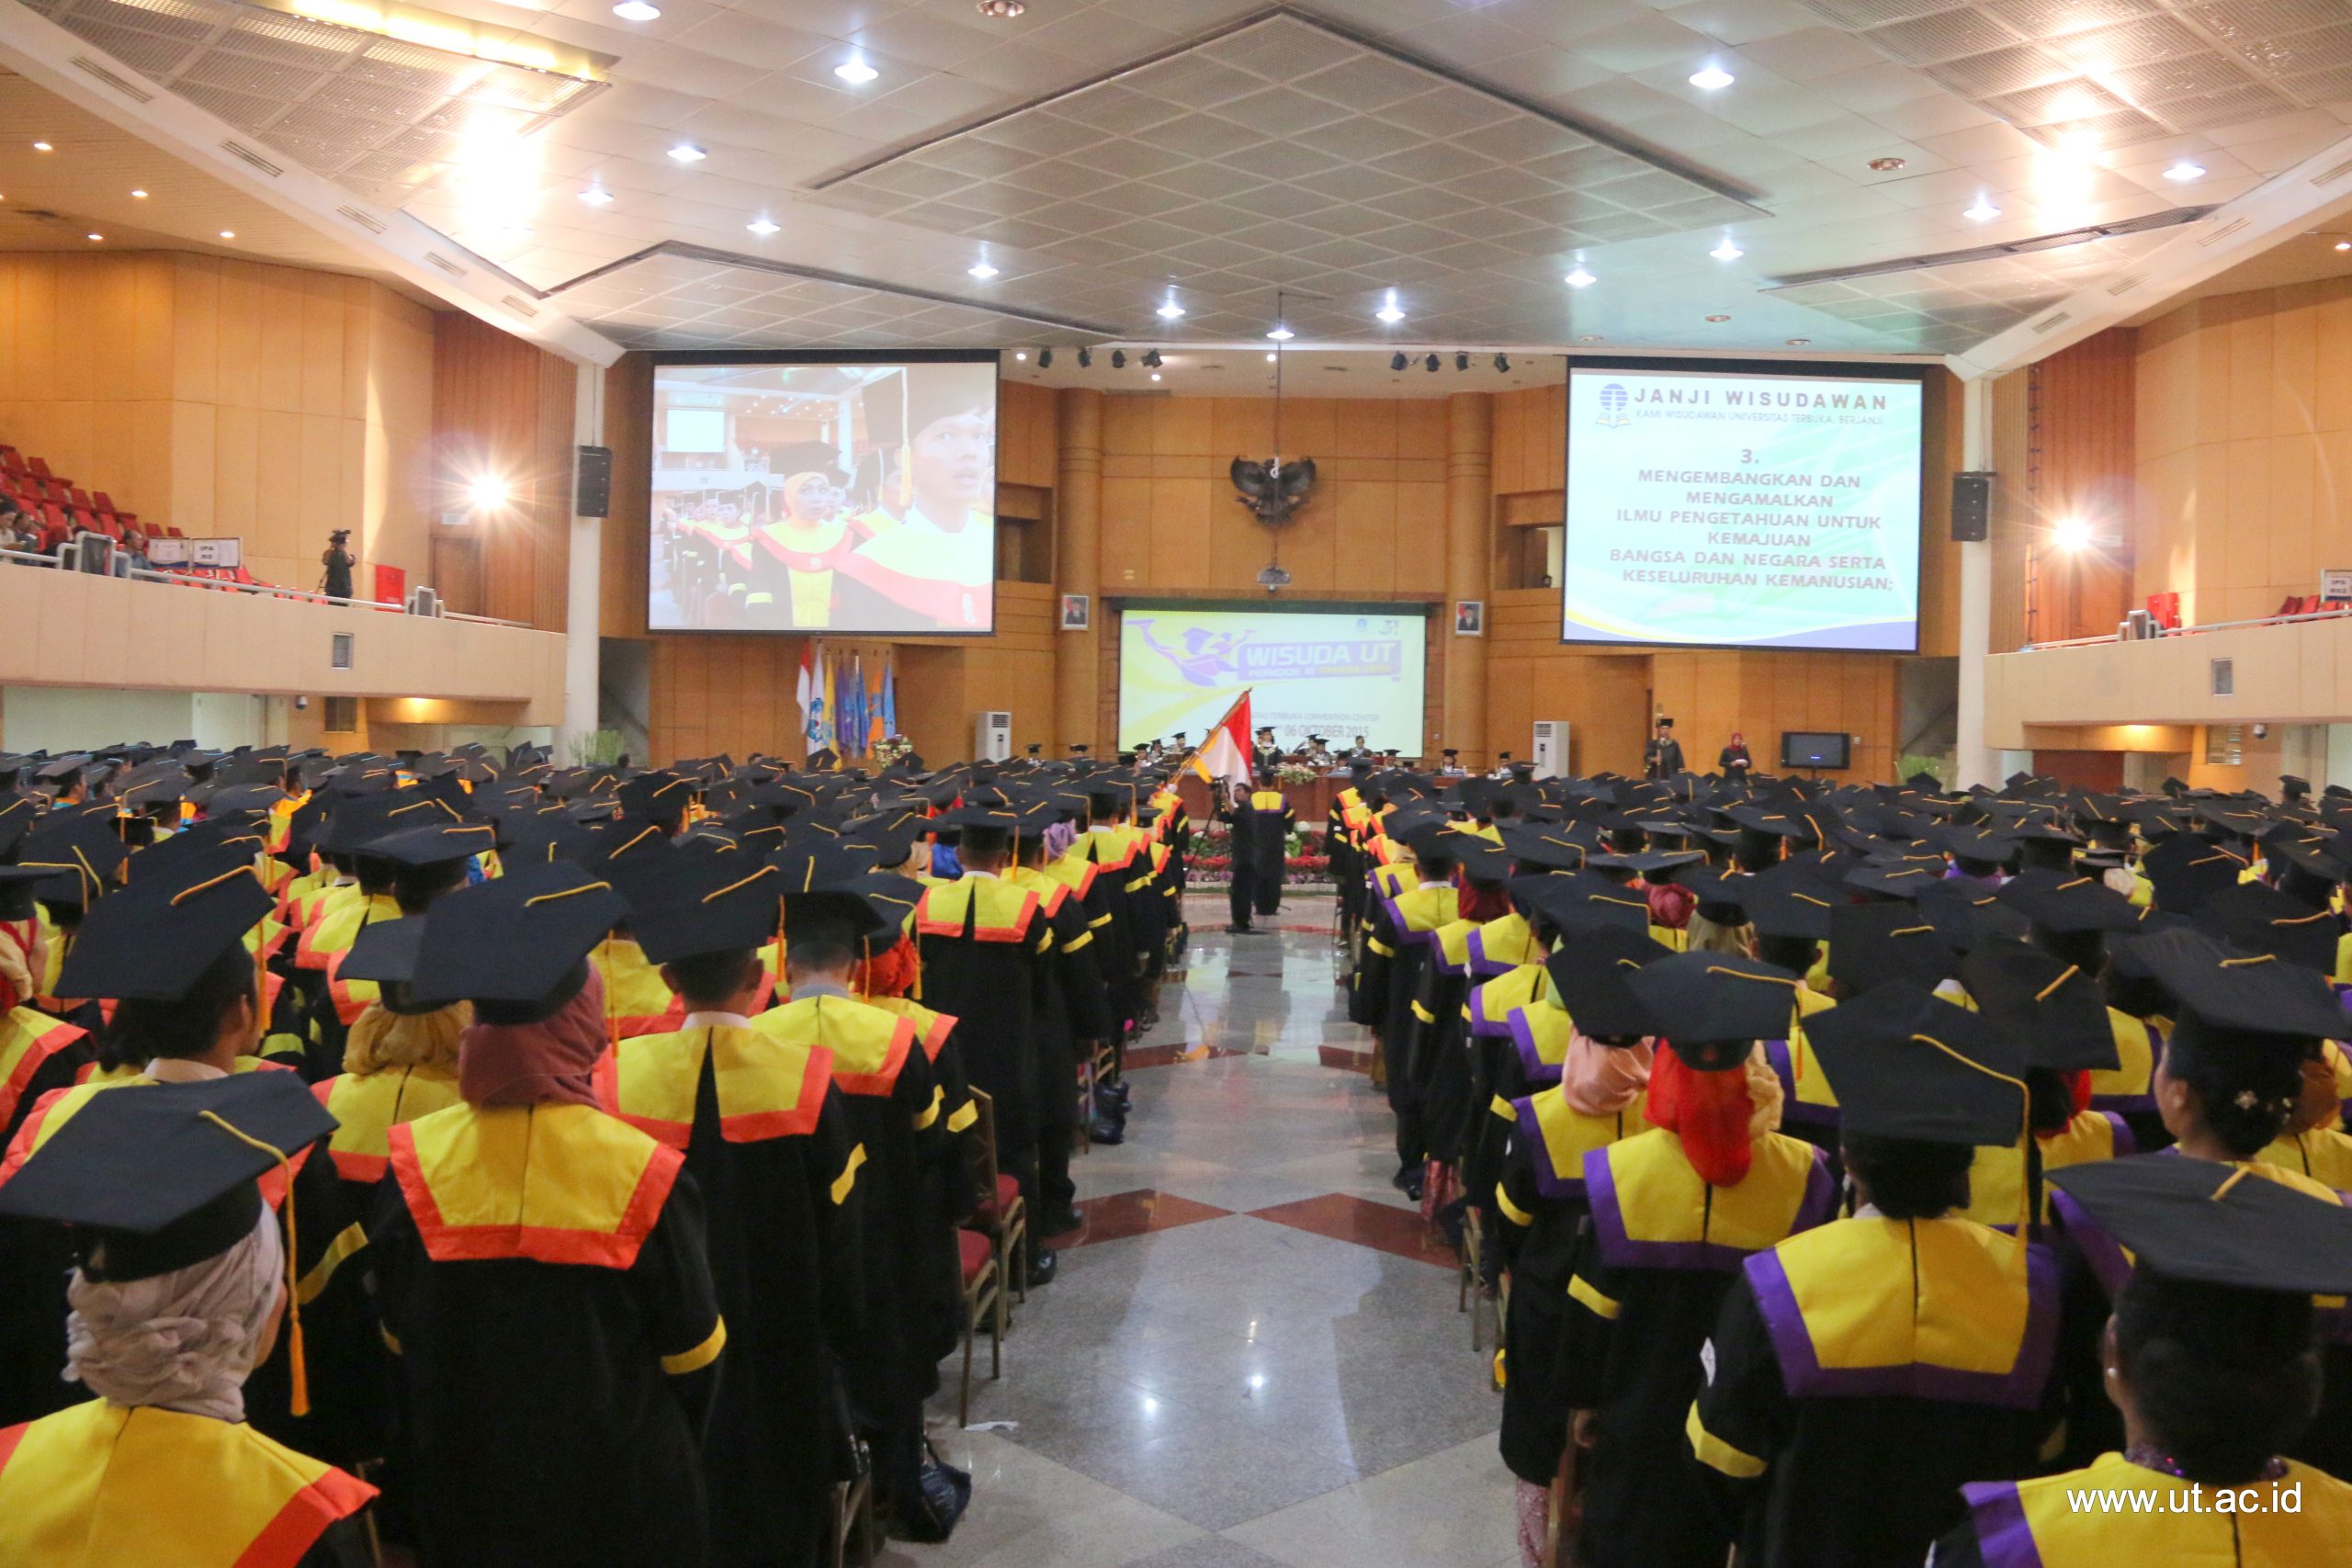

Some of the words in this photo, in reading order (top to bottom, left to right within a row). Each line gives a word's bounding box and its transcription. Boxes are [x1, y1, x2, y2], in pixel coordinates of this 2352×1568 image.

[1634, 388, 1711, 404] JANJI
[1725, 390, 1887, 411] WISUDAWAN
[1635, 410, 1662, 419] KAMI
[1665, 411, 1725, 421] WISUDAWAN
[1728, 412, 1789, 423] UNIVERSITAS
[1838, 415, 1883, 425] BERJANJI
[1741, 449, 1759, 465] 3.
[1638, 469, 1813, 487] MENGEMBANGKAN
[1820, 475, 1861, 488] DAN
[1686, 491, 1834, 507] MENGAMALKAN
[1617, 509, 1662, 523] ILMU
[1670, 511, 1809, 527] PENGETAHUAN
[1817, 515, 1882, 529] UNTUK
[1707, 532, 1811, 547] KEMAJUAN
[1610, 548, 1686, 563] BANGSA
[1694, 551, 1735, 565] DAN
[1743, 553, 1821, 568] NEGARA
[1829, 555, 1886, 570] SERTA
[1623, 570, 1757, 586] KESELURUHAN
[1246, 645, 1352, 667] WISUDA
[1359, 642, 1396, 663] UT
[1284, 725, 1297, 737] 06
[1298, 725, 1345, 738] OKTOBER
[1347, 726, 1370, 738] 2015
